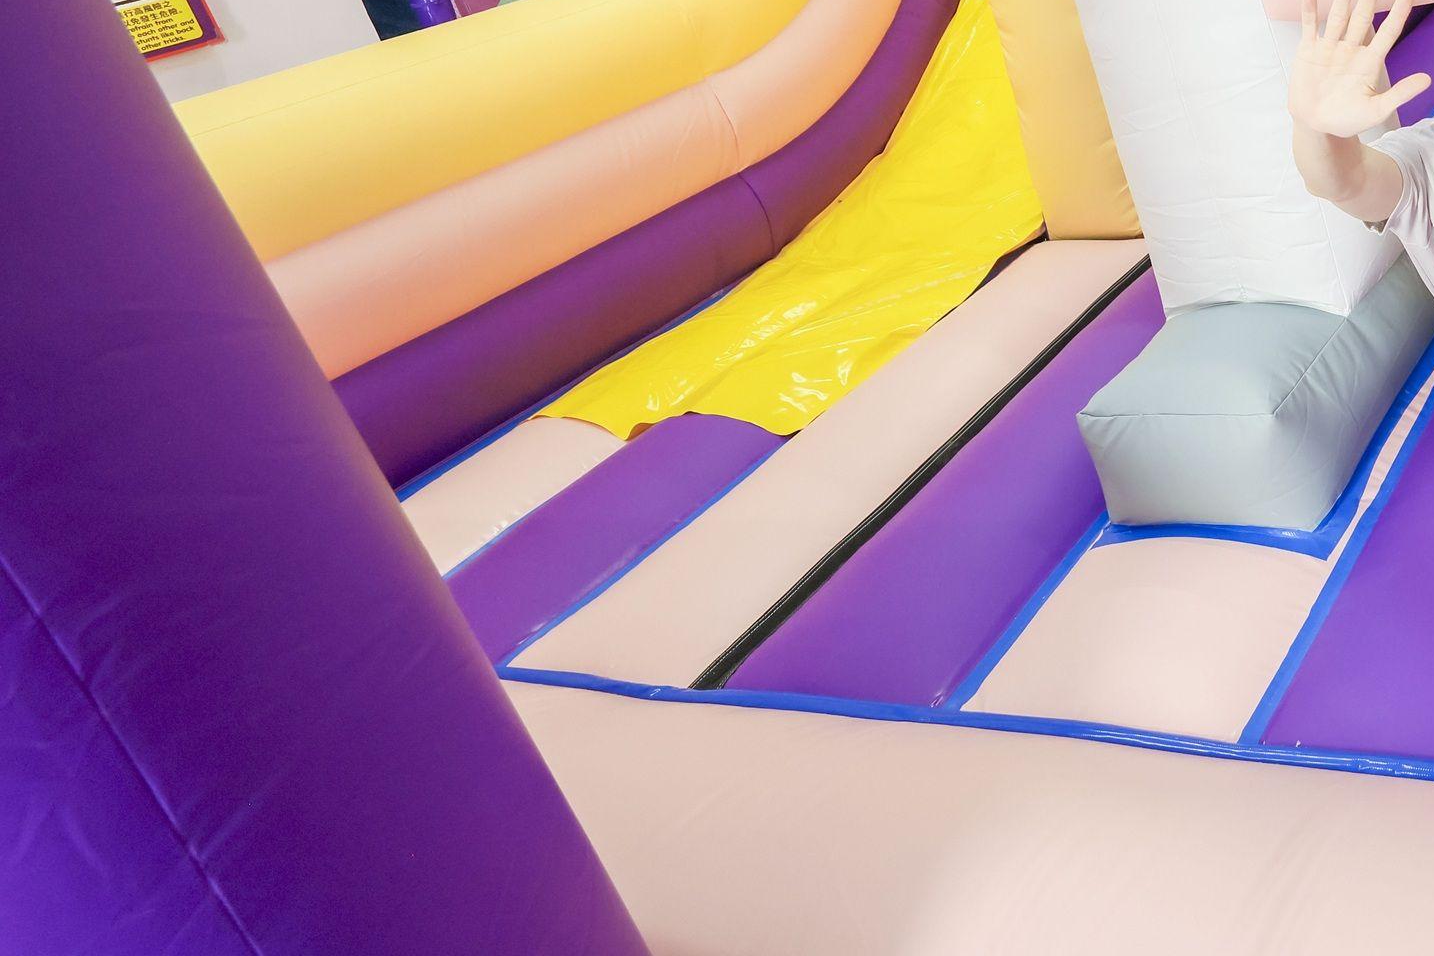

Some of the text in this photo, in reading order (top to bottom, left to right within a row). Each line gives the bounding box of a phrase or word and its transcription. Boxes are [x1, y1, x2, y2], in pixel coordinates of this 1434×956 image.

[136, 35, 160, 44] stunts
[177, 26, 194, 34] back
[137, 29, 156, 37] each
[158, 24, 178, 32] other
[141, 42, 161, 50] other
